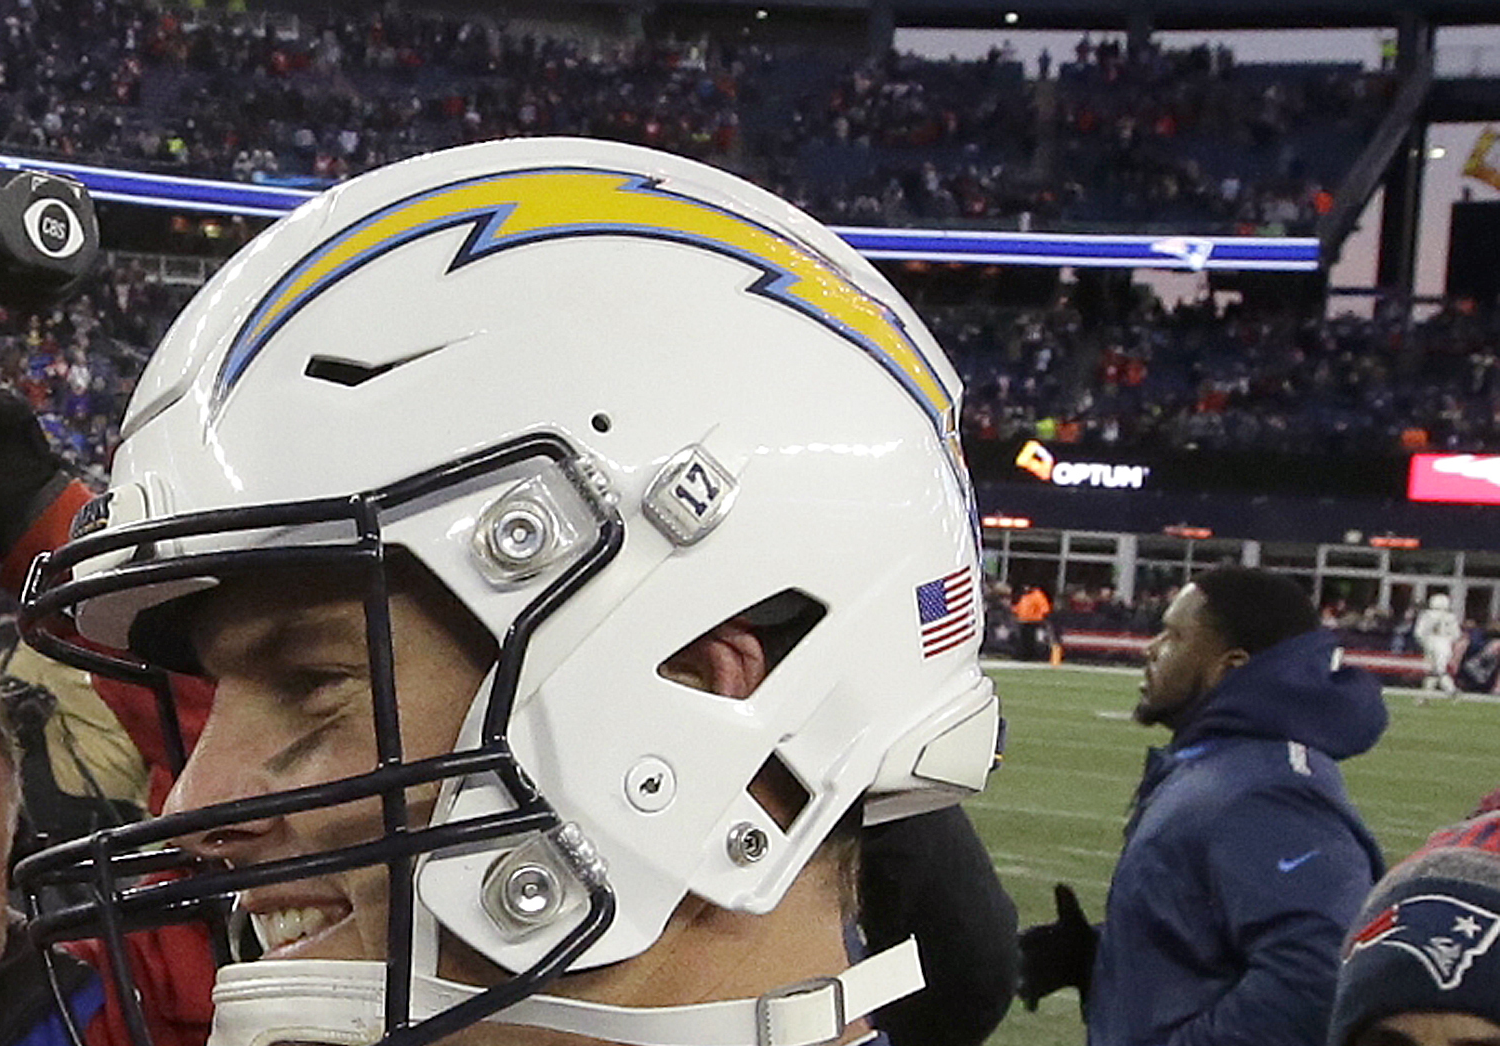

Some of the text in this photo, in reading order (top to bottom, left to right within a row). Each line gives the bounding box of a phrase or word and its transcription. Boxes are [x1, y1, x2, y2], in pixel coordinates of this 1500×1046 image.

[42, 216, 66, 239] CBS
[1051, 461, 1144, 489] OPTUM
[675, 462, 720, 517] 17
